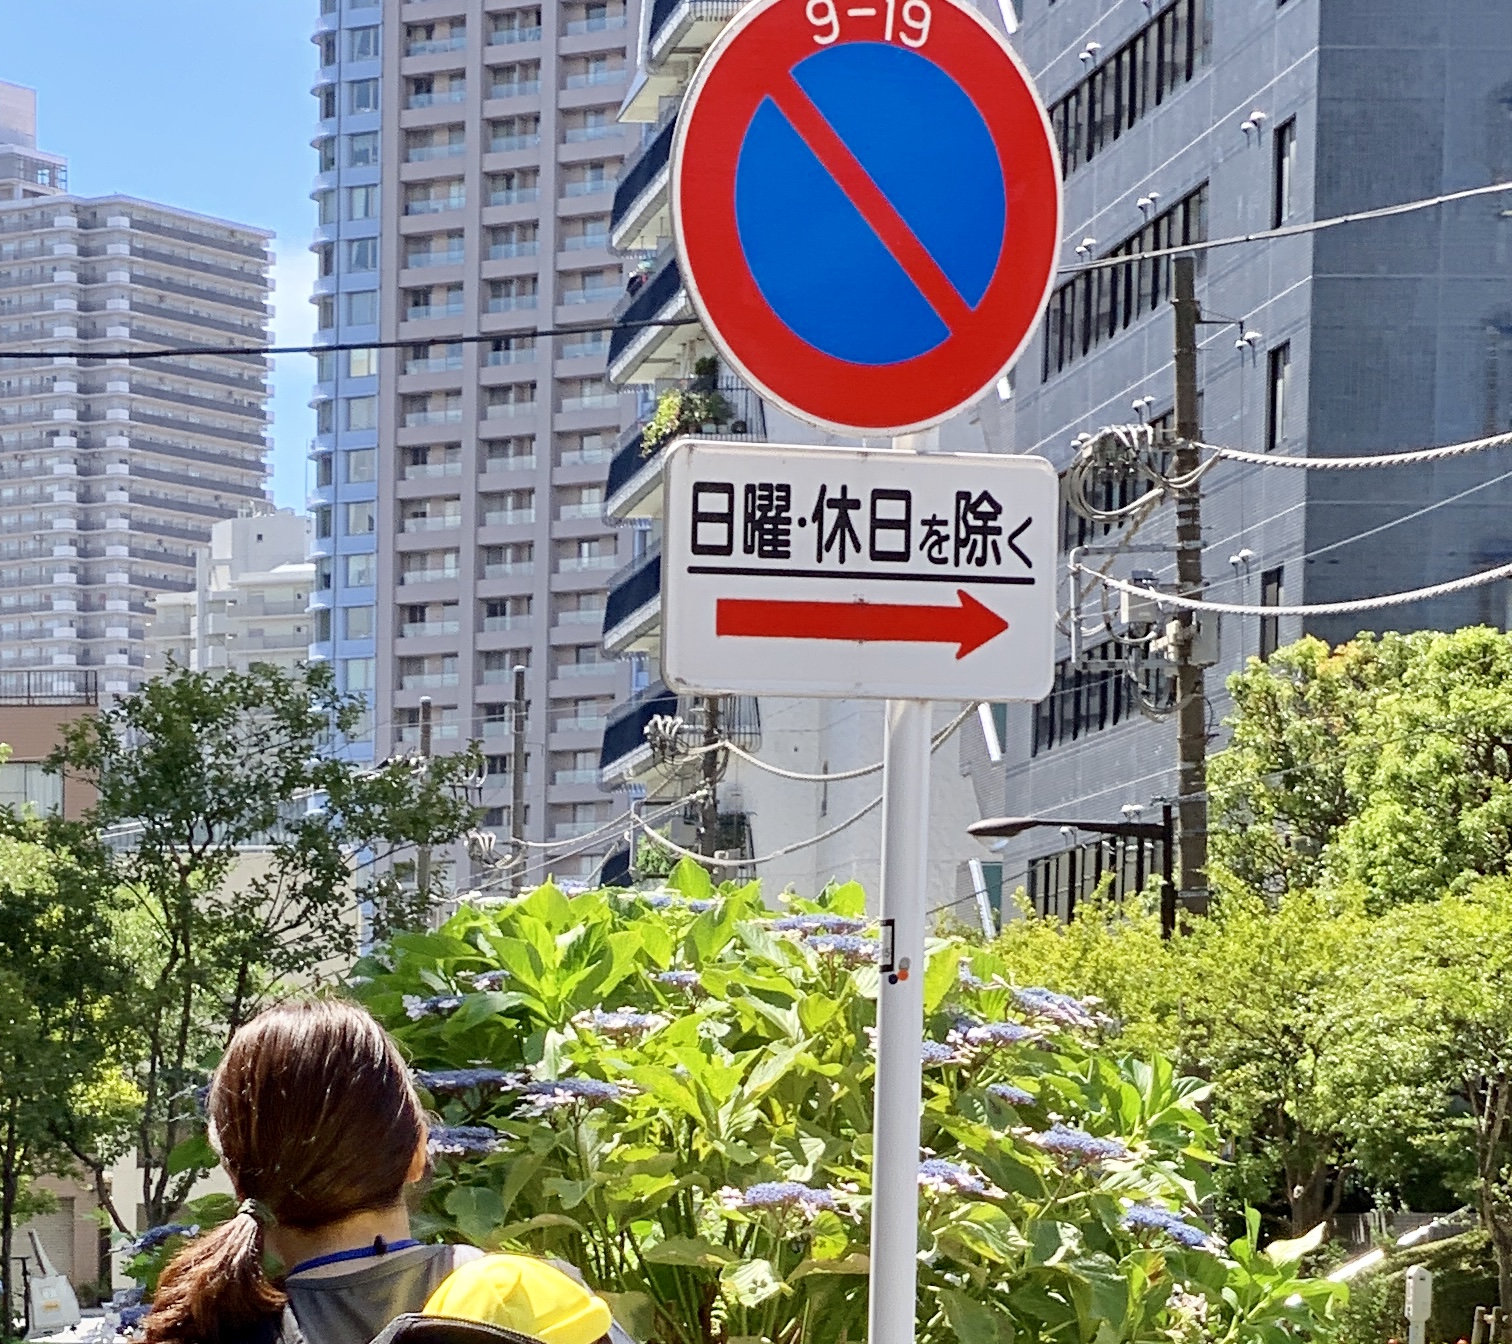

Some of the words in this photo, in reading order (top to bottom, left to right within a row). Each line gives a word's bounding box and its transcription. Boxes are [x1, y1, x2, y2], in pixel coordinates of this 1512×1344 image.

[805, 0, 933, 48] 9-19
[691, 481, 1034, 569] 日曜・休日を除く
